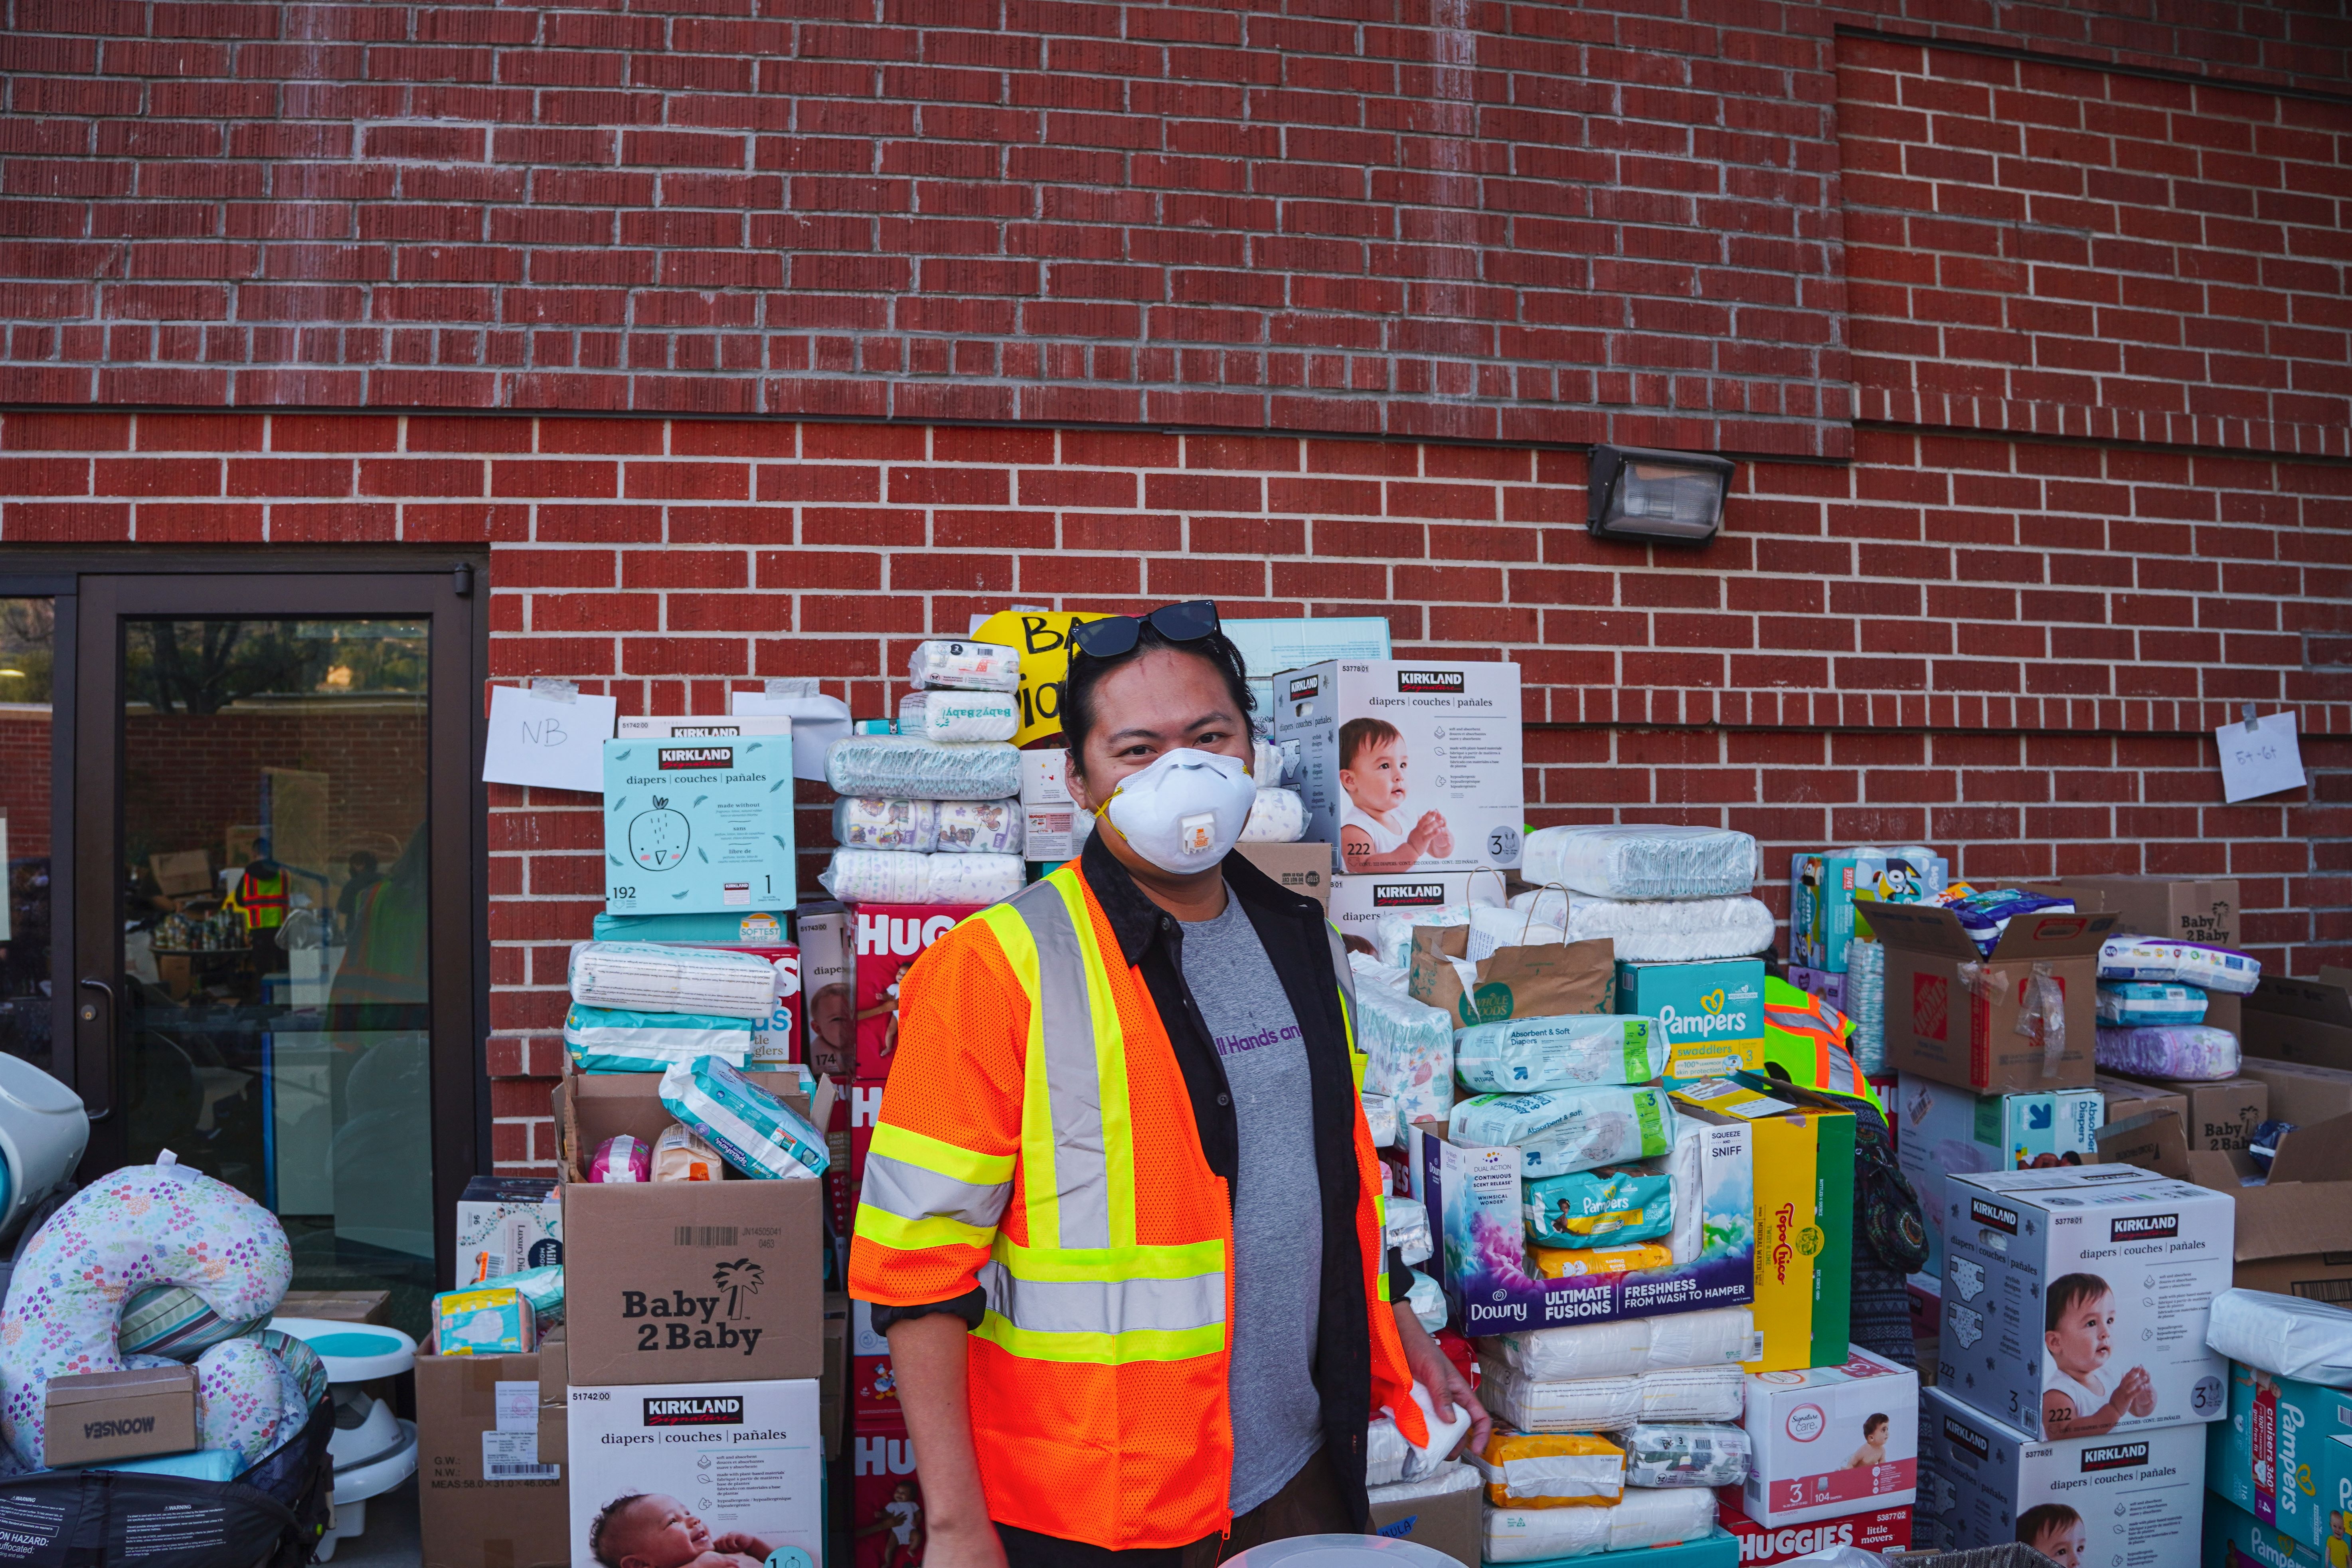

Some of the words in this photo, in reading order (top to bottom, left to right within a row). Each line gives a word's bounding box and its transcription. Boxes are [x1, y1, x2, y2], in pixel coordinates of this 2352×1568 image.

[1291, 677, 1317, 692] KIRKLAND
[1401, 673, 1462, 684] KIRKLAND
[1401, 684, 1461, 692] Signature
[1370, 697, 1405, 707] diapers
[1413, 697, 1450, 706] couches
[1457, 697, 1492, 708] pañales
[522, 718, 567, 746] NB
[1280, 723, 1294, 733] diapers
[1296, 718, 1312, 729] couches
[1314, 715, 1332, 727] pañales
[662, 749, 731, 761] KIRKLAND
[662, 761, 730, 770] Signature
[627, 774, 667, 785] diapers
[674, 773, 717, 783] couches
[726, 773, 766, 783] pañales
[1348, 843, 1370, 855] 222
[1491, 836, 1502, 855] 3
[765, 874, 771, 894] 1
[1378, 886, 1442, 898] KIRKLAND
[613, 887, 636, 899] 192
[1378, 898, 1441, 906] Signature
[1343, 912, 1381, 922] diapers
[2181, 915, 2215, 929] Baby
[2196, 929, 2229, 944] Baby
[1660, 1005, 1746, 1038] Pampers
[1511, 1029, 1548, 1038] Absorbent
[1555, 1027, 1570, 1036] Soft
[1637, 1024, 1646, 1036] 3
[1225, 1028, 1279, 1054] Hands
[1677, 1044, 1732, 1056] swaddlers
[1746, 1050, 1753, 1062] 3
[816, 1054, 836, 1066] 174
[1648, 1093, 1656, 1106] 3
[1527, 1116, 1563, 1136] Absorbent
[1569, 1109, 1583, 1118] Soft
[2077, 1101, 2088, 1143] Diapers
[2088, 1101, 2098, 1153] Absorben
[2204, 1122, 2242, 1138] Baby
[1712, 1145, 1742, 1157] SNIFF
[752, 1162, 773, 1178] Pampers
[1583, 1197, 1629, 1215] Pampers
[1973, 1200, 2016, 1226] KIRKLAND
[1775, 1202, 1795, 1242] Topo
[2114, 1216, 2176, 1233] KIRKLAND
[742, 1227, 782, 1236] JN14505041
[515, 1225, 526, 1257] Luxury
[759, 1239, 775, 1248] 0463
[1951, 1236, 1975, 1253] diapers
[1979, 1245, 2006, 1264] couches
[2011, 1259, 2038, 1276] pañales
[2080, 1246, 2117, 1260] diapers
[2124, 1243, 2163, 1256] couches
[2170, 1240, 2206, 1255] pañales
[1773, 1243, 1793, 1285] Chico
[1545, 1285, 1611, 1306] ULTIMATE
[1625, 1279, 1696, 1298] FRESHNESS
[1625, 1296, 1654, 1309] FROM
[1656, 1293, 1686, 1304] WASH
[1688, 1290, 1702, 1301] TO
[1705, 1285, 1745, 1298] HAMPER
[622, 1290, 719, 1324] Baby
[1471, 1303, 1528, 1321] Downy
[1545, 1300, 1611, 1320] FUSIONS
[638, 1324, 658, 1350] 2
[666, 1322, 762, 1356] Baby
[1940, 1362, 1955, 1379] 222
[2009, 1390, 2018, 1413] 3
[2194, 1387, 2206, 1408] 3
[649, 1400, 740, 1414] KIRKLAND
[2049, 1408, 2071, 1422] 222
[84, 1416, 155, 1439] MOONSEA
[649, 1414, 739, 1426] Signature
[1791, 1414, 1818, 1426] Signature
[1796, 1422, 1816, 1432] care
[601, 1434, 654, 1446] diapers
[665, 1432, 722, 1443] couches
[733, 1430, 787, 1443] pañales
[1945, 1419, 1987, 1451] KIRKLAND
[2085, 1444, 2146, 1463] KIRKLAND
[2279, 1402, 2305, 1515] Pampers
[2050, 1478, 2088, 1491] diapers
[2094, 1473, 2134, 1485] couches
[2140, 1467, 2176, 1481] pañales
[1790, 1483, 1803, 1503] 3
[1815, 1492, 1830, 1503] 104
[2261, 1501, 2271, 1513] 4
[1867, 1525, 1888, 1536] little
[11, 1534, 49, 1546] HAZARD:
[1736, 1523, 1853, 1562] HUGGIES
[1861, 1534, 1893, 1544] movers
